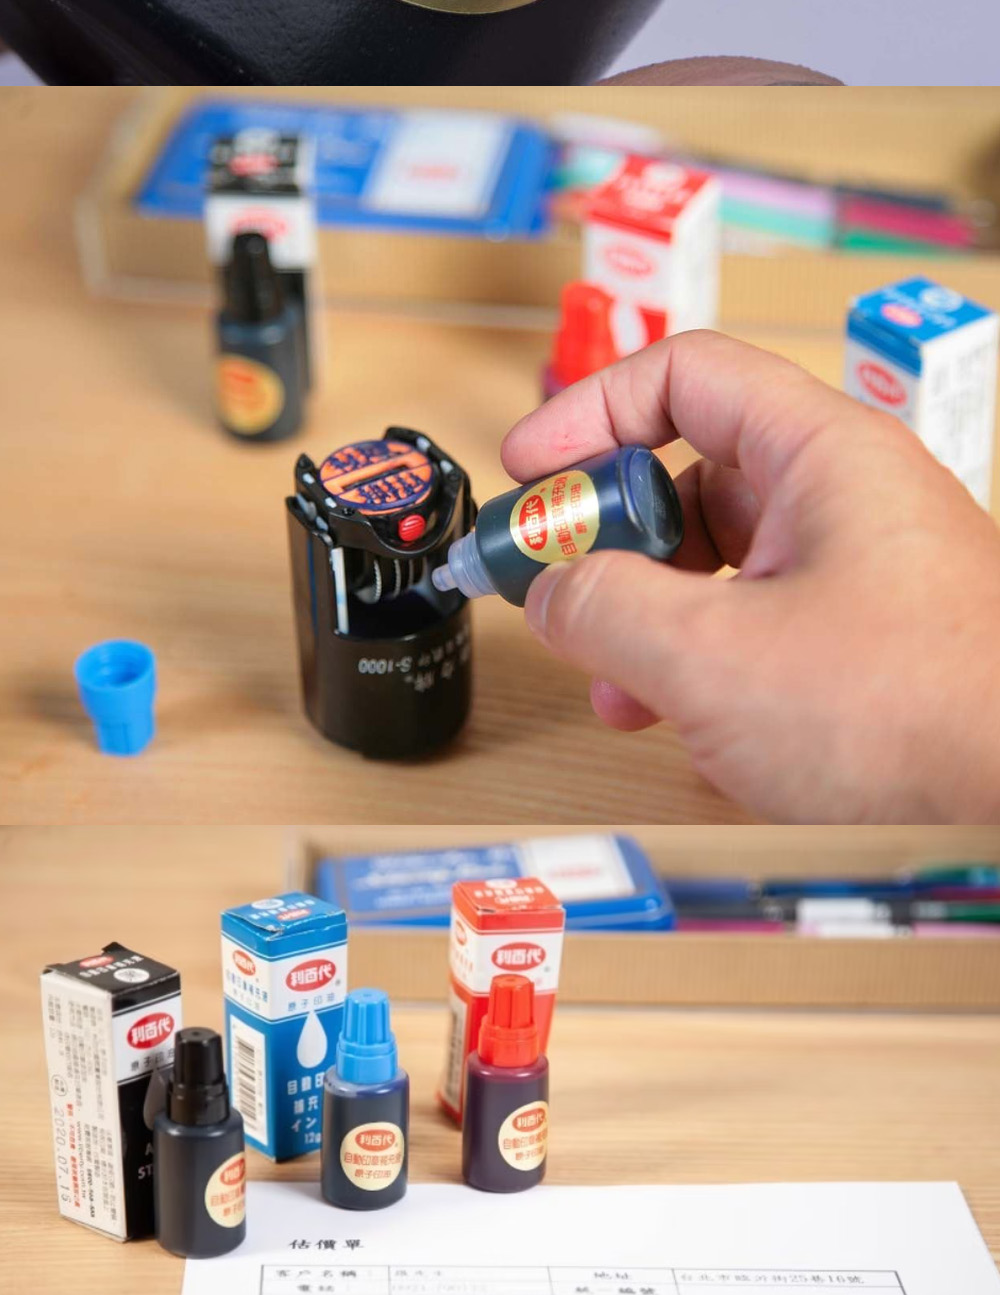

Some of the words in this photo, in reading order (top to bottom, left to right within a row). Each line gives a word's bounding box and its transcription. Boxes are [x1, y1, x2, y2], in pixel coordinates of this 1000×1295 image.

[525, 498, 544, 546] 利百代
[358, 656, 413, 675] S-1000
[495, 948, 542, 965] 利百代
[289, 963, 333, 988] 利百代
[130, 1016, 172, 1046] 利百代
[360, 1134, 395, 1147] 利百代
[289, 1238, 364, 1251] 估價單
